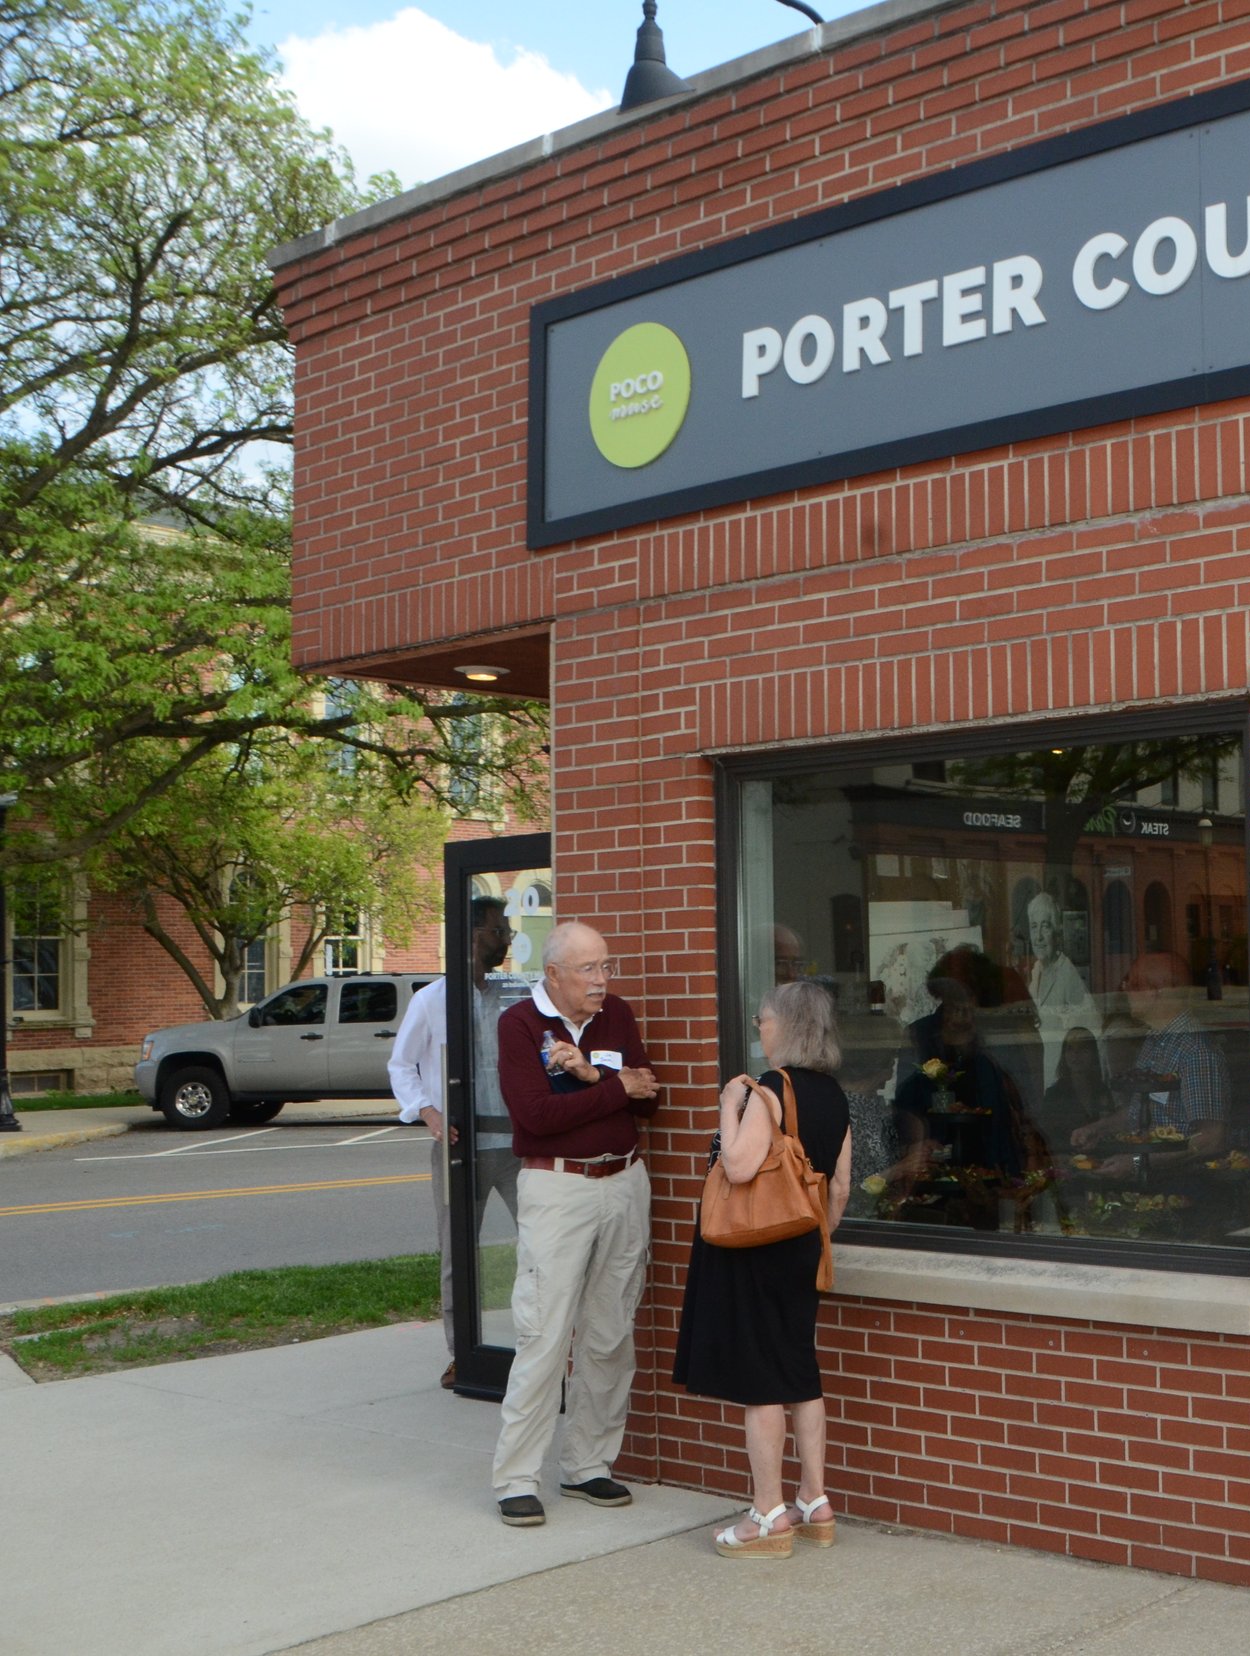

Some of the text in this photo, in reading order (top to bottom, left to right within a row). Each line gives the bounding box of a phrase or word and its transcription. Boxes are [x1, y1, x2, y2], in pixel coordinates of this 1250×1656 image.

[742, 255, 1046, 398] PORTER
[609, 370, 664, 402] POCO
[609, 394, 664, 420] muse
[503, 886, 540, 917] 20
